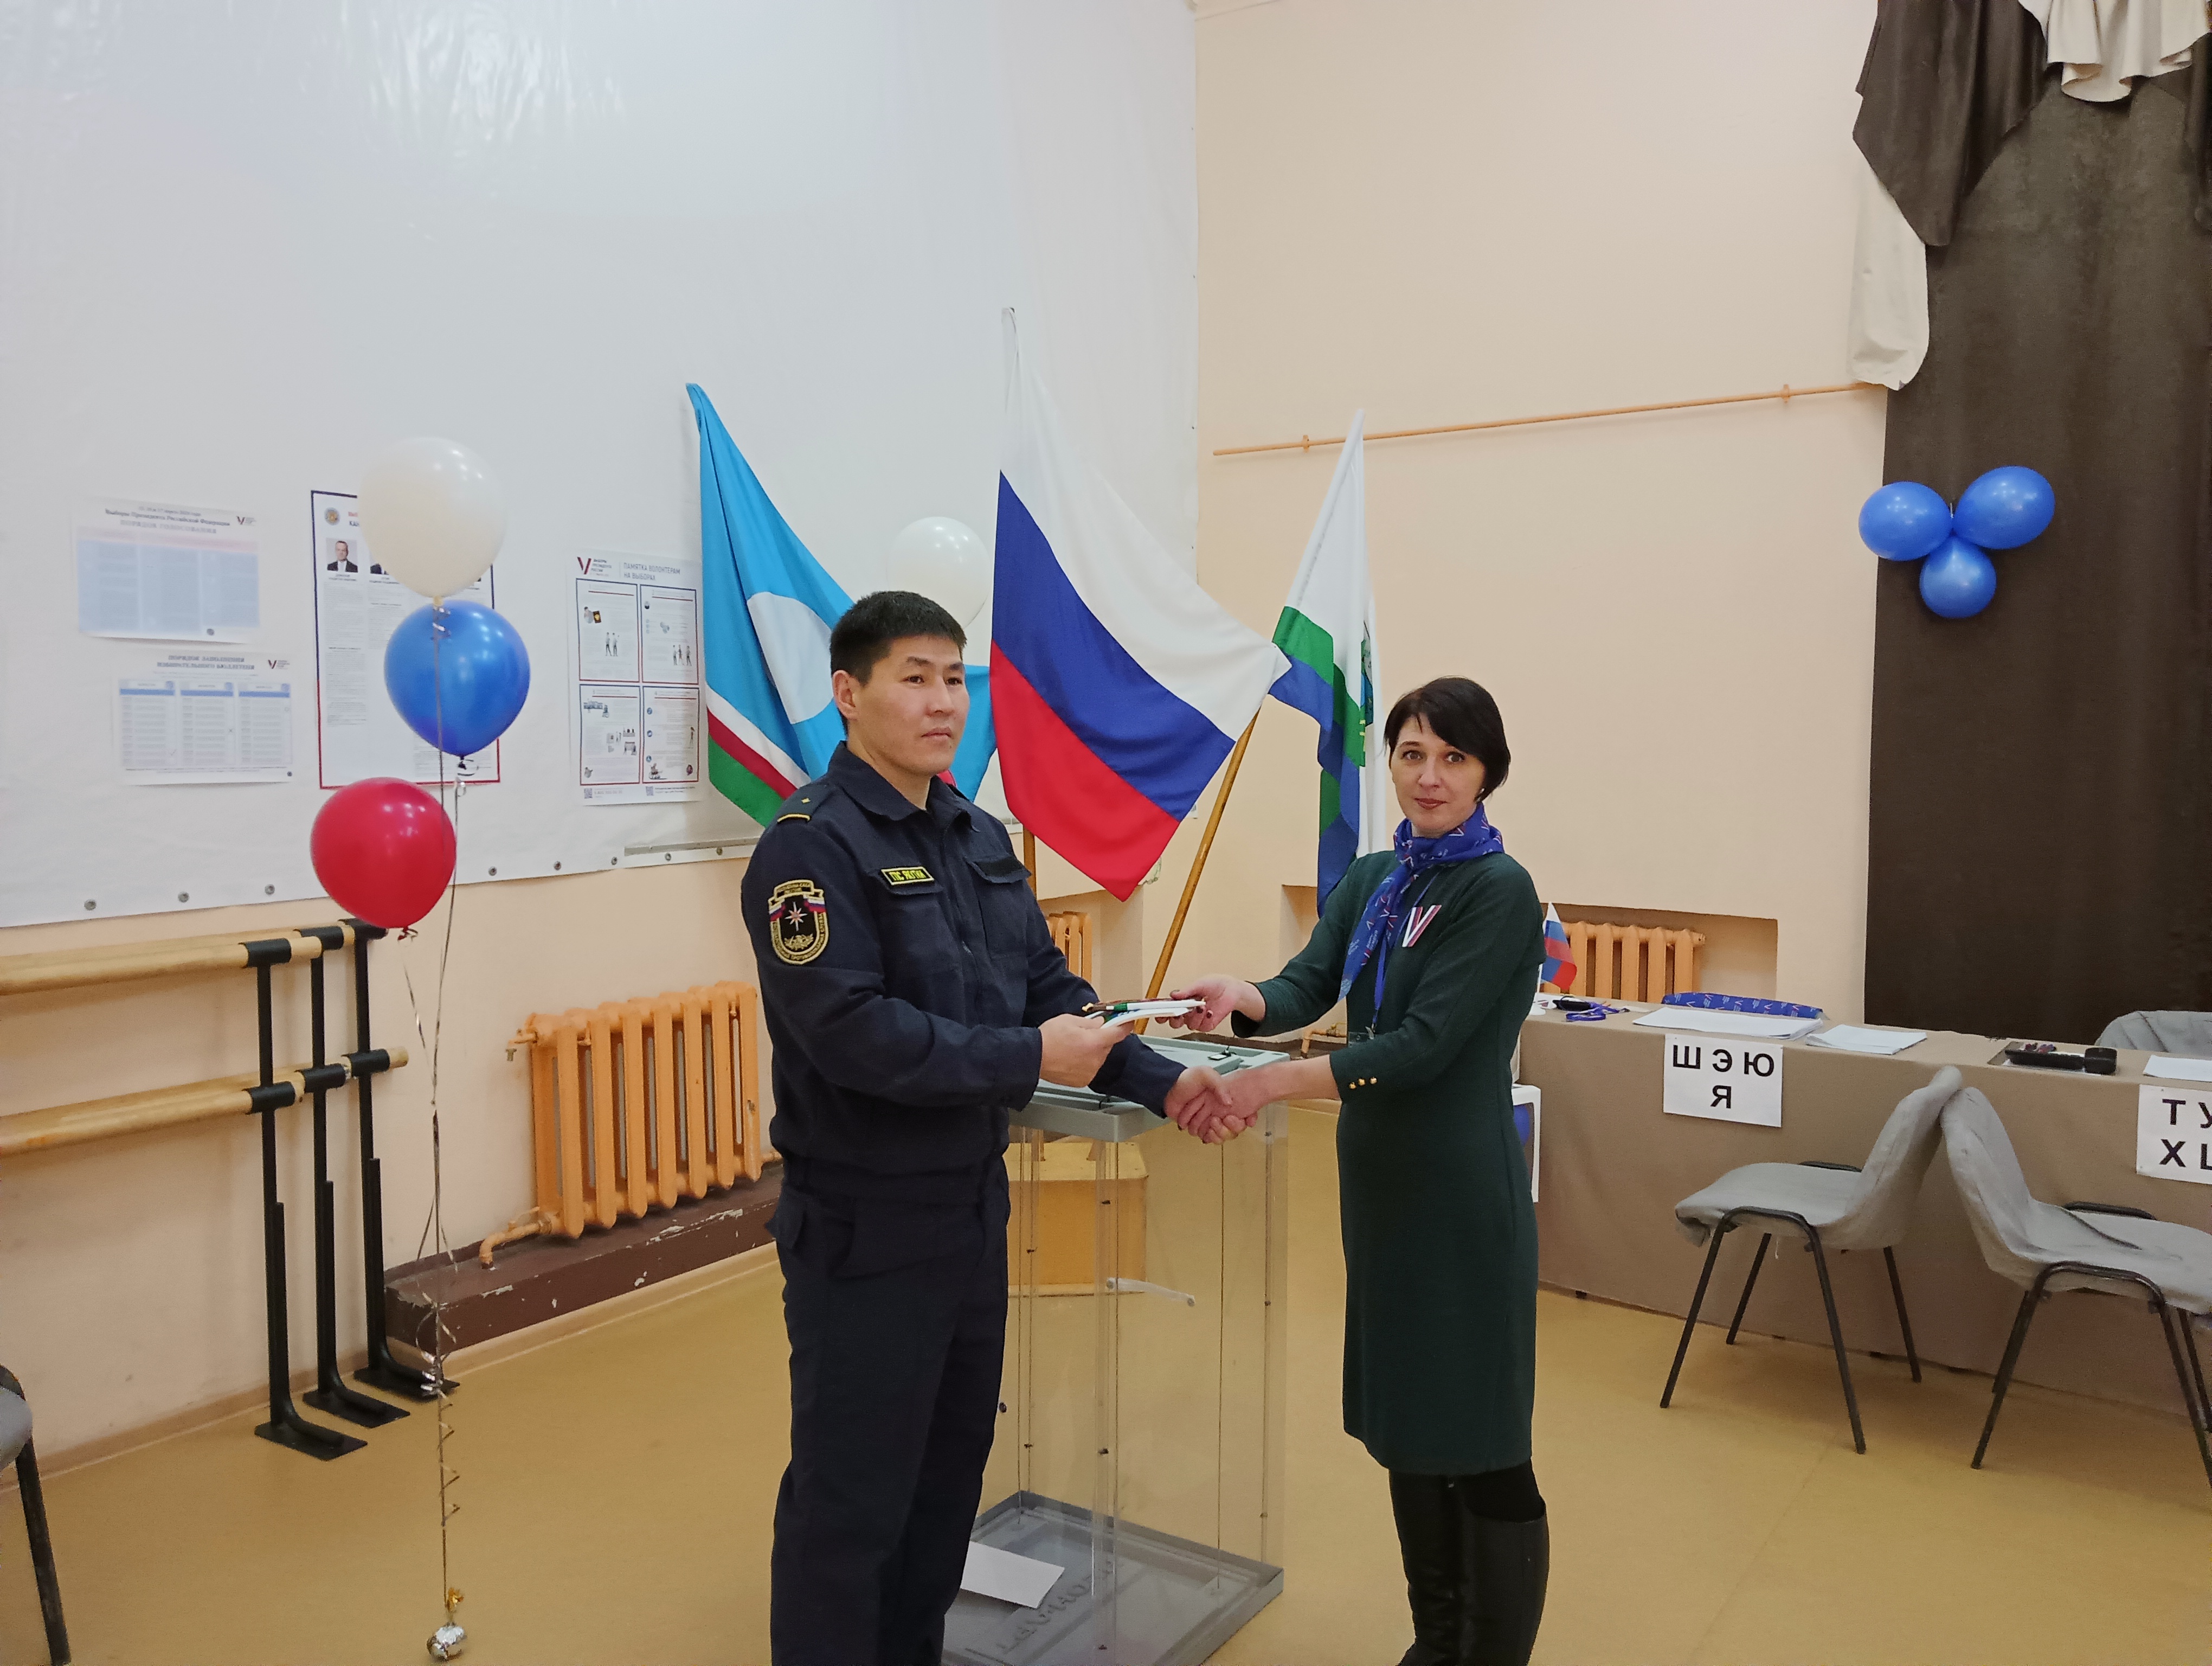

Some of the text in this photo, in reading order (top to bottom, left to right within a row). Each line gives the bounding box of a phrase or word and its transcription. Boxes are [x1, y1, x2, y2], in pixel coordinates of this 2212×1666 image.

[624, 562, 680, 575] ПАМЯТКА ВОЛОНТЕРАМ
[1673, 1045, 1774, 1077] Ш Э Ю
[1711, 1085, 1732, 1109] Я
[2162, 1099, 2186, 1125] Т
[2159, 1139, 2187, 1168] Х
